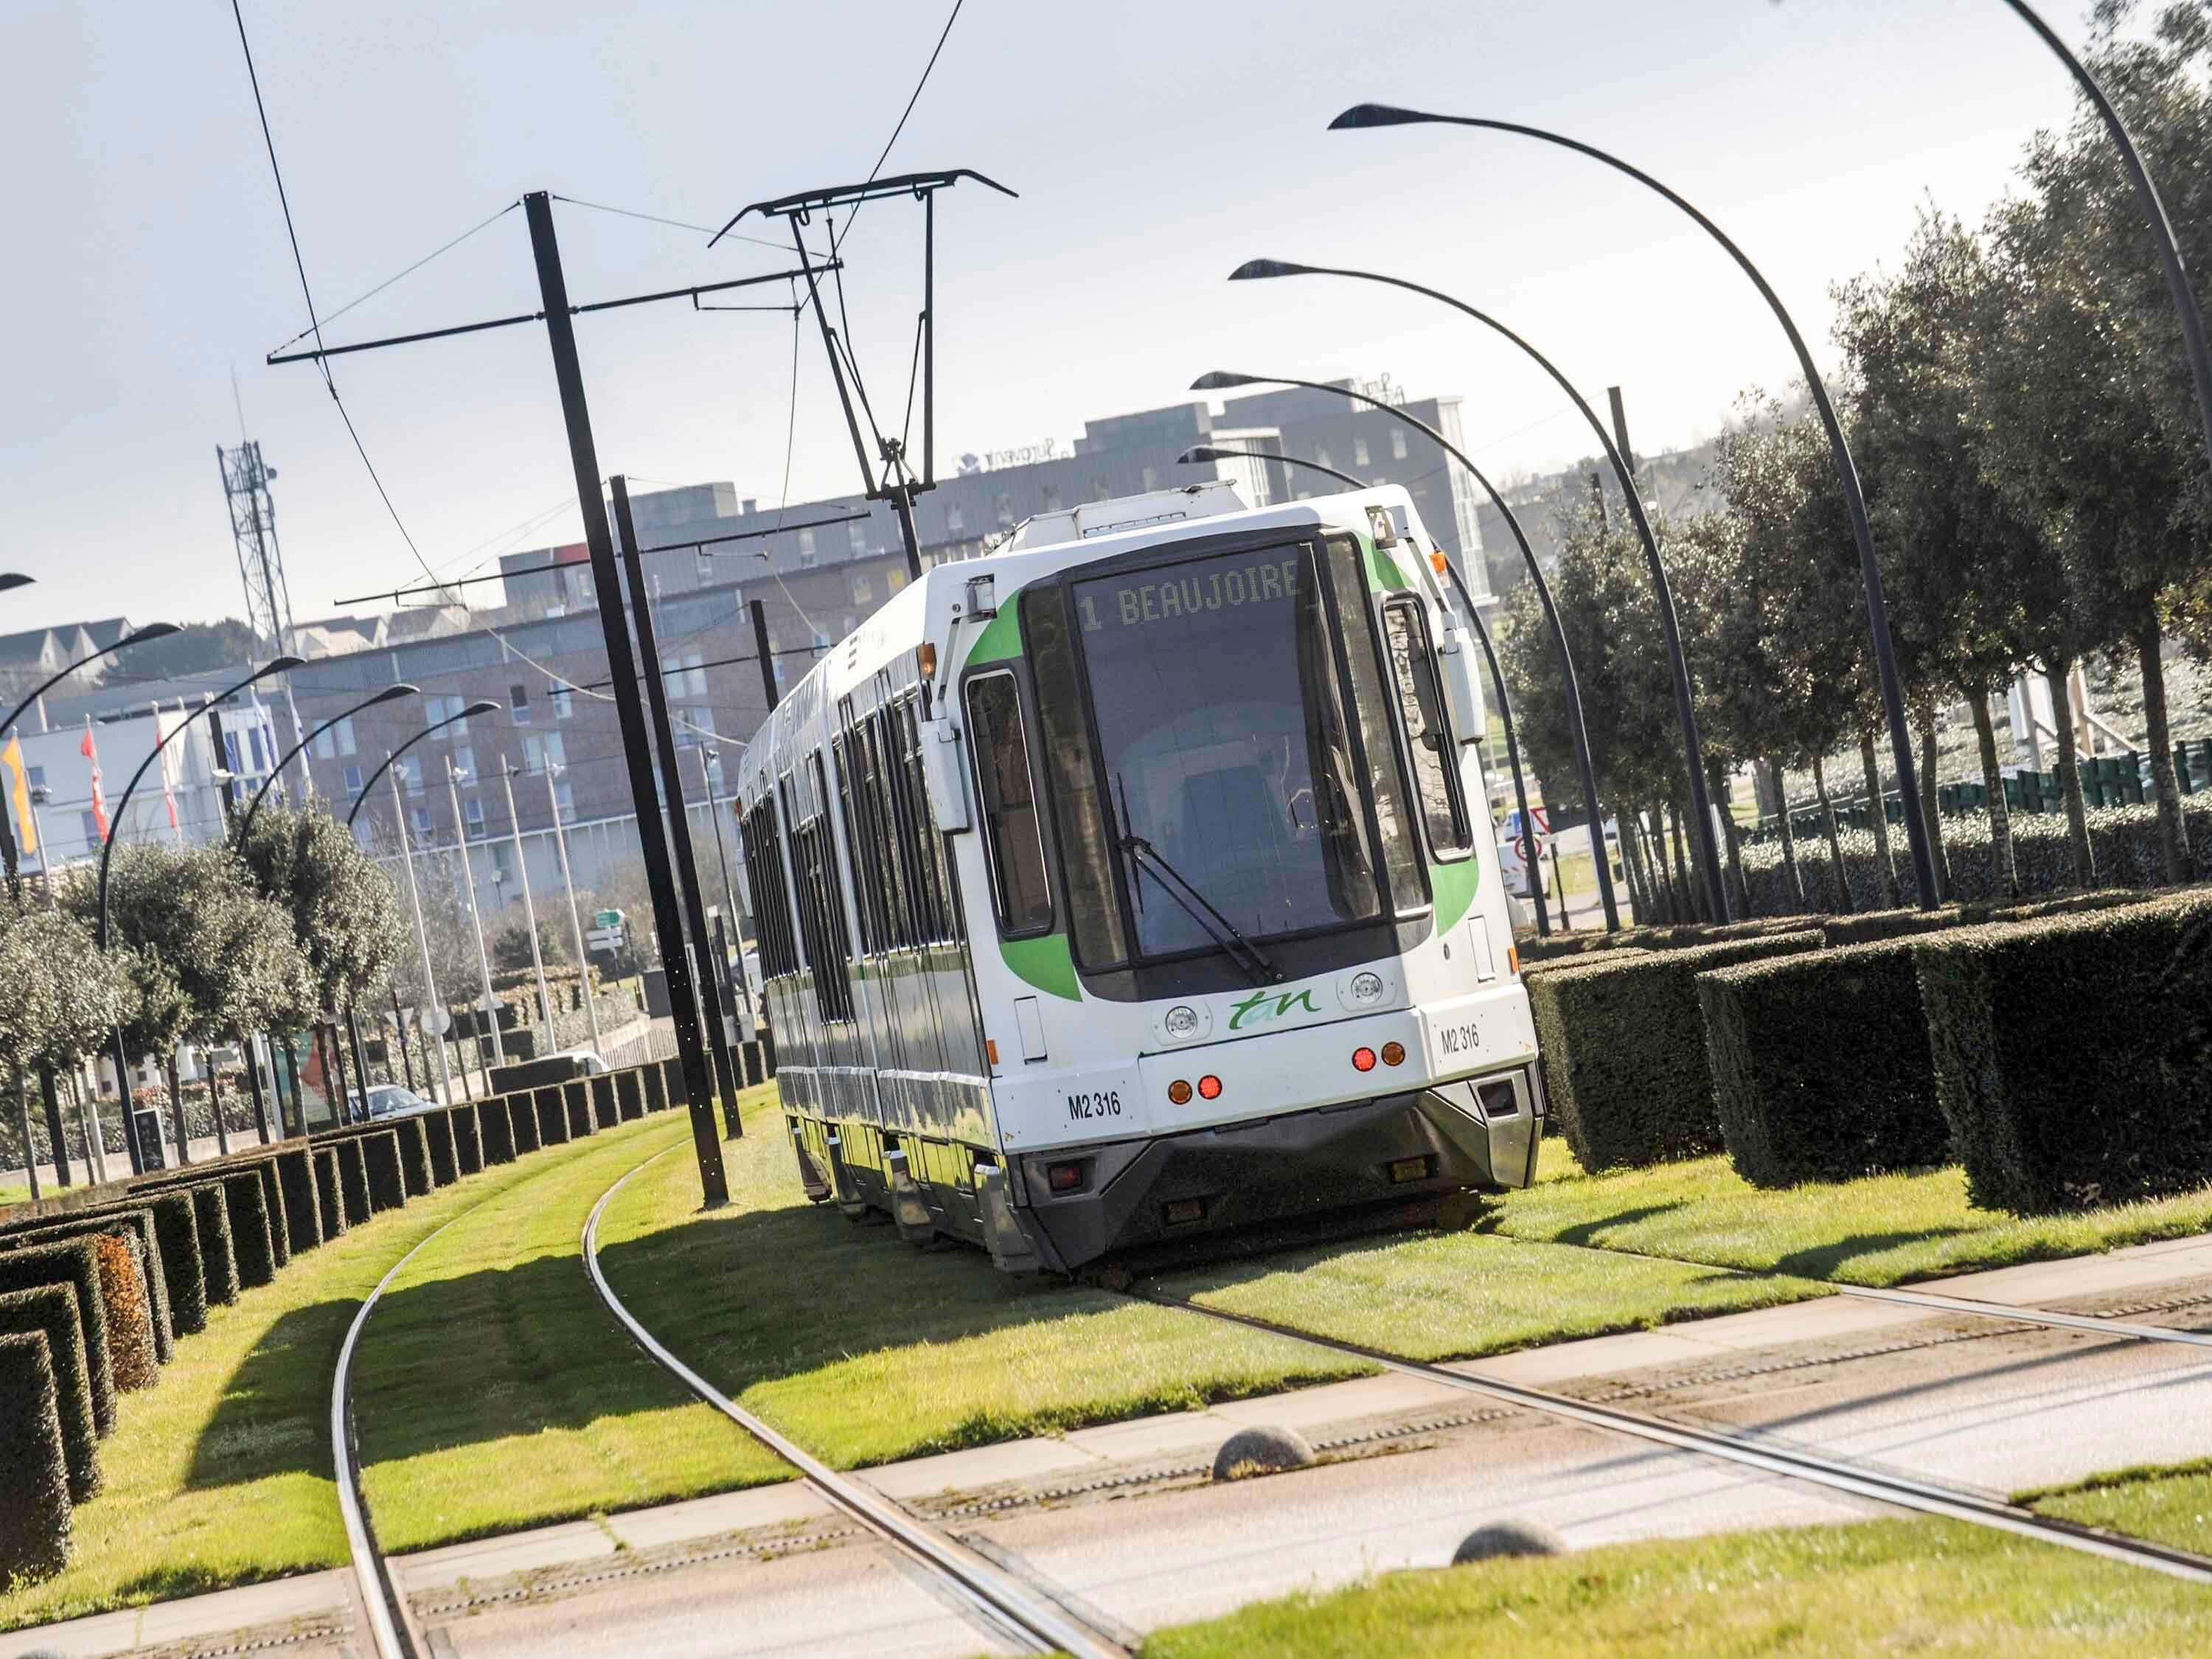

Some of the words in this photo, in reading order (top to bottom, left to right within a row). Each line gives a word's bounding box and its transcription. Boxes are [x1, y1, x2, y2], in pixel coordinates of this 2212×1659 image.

[1079, 596, 1103, 632] 1
[1117, 560, 1300, 626] BEAUJOIRE
[1229, 990, 1322, 1030] tan
[1441, 1029, 1459, 1055] M2
[1460, 1023, 1480, 1050] 316
[1068, 1094, 1093, 1120] M2
[1093, 1091, 1121, 1117] 316
